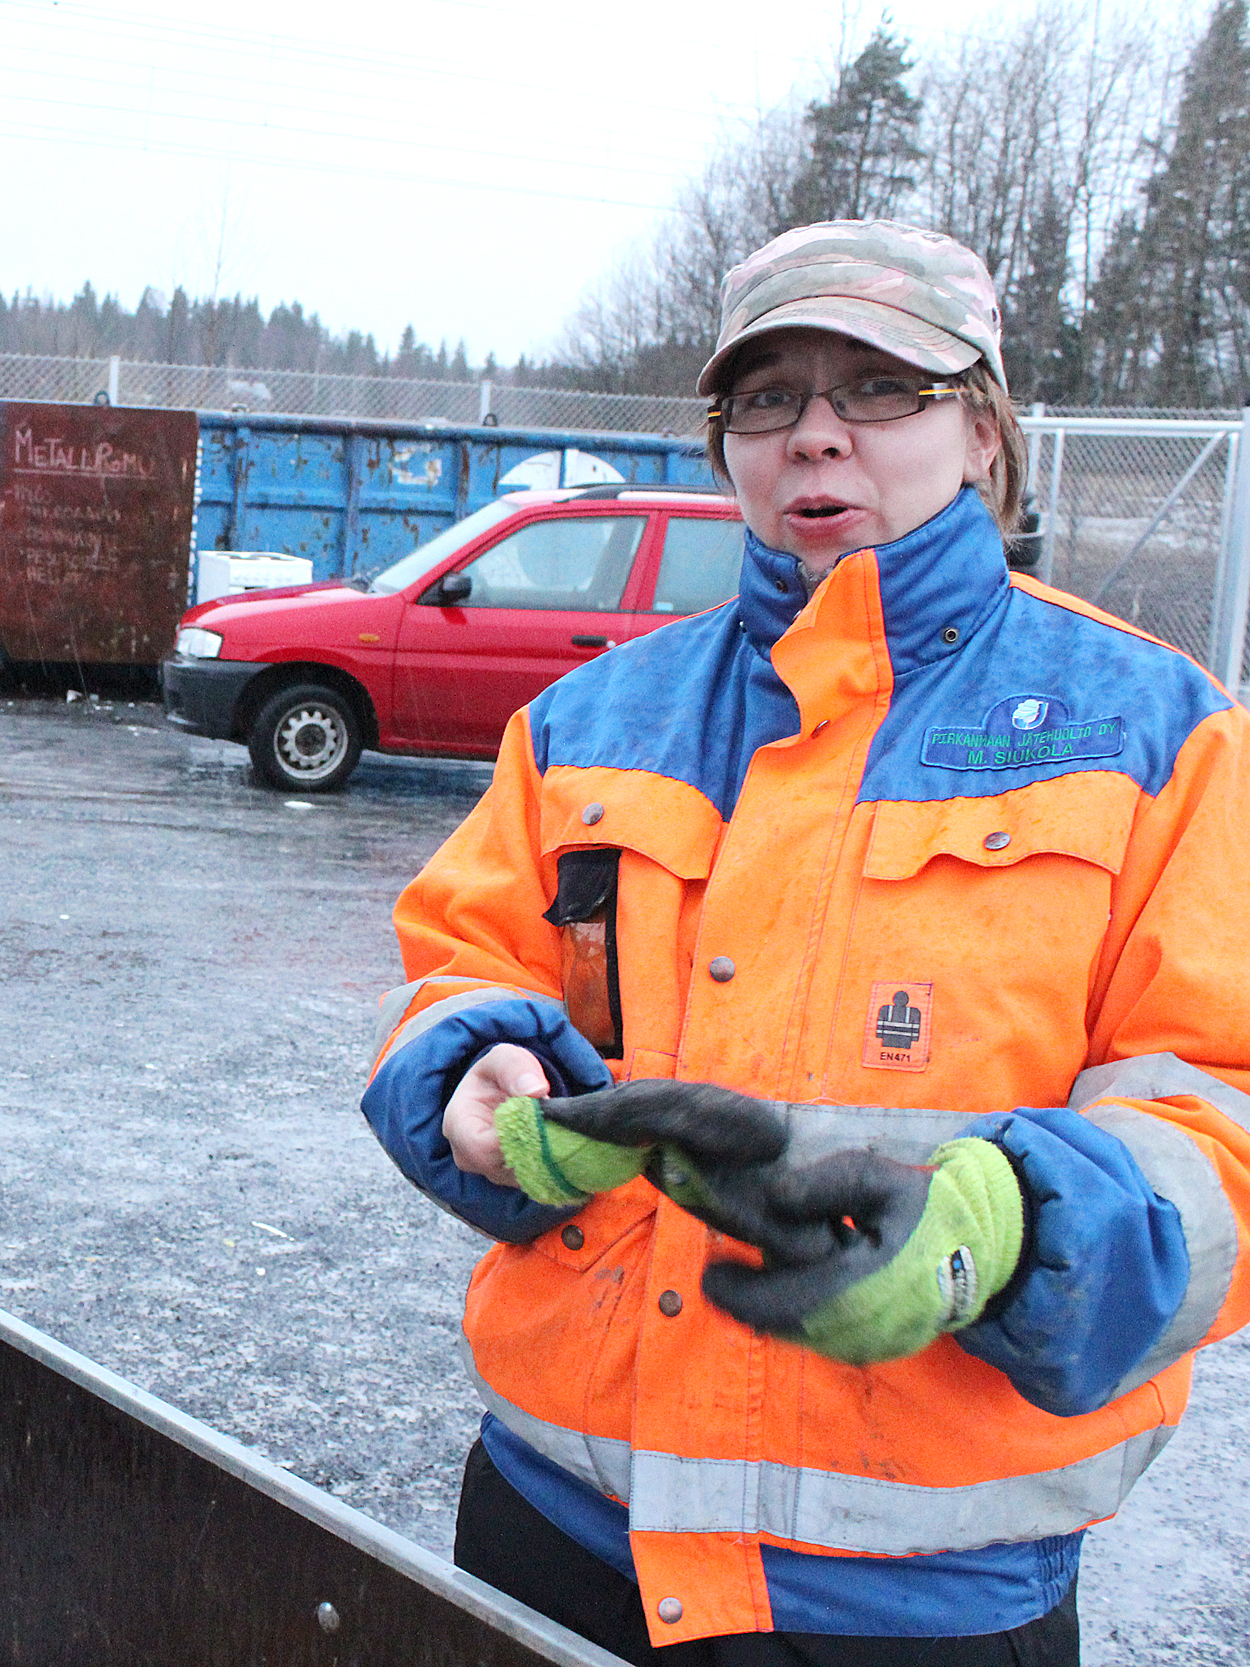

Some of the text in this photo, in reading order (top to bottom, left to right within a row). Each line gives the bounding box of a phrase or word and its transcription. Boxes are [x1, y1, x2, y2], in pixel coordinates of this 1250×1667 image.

[931, 723, 1117, 748] PIRKANMAAN JÄTEHUOLTO OY
[967, 743, 1074, 764] M. SIUKOLA
